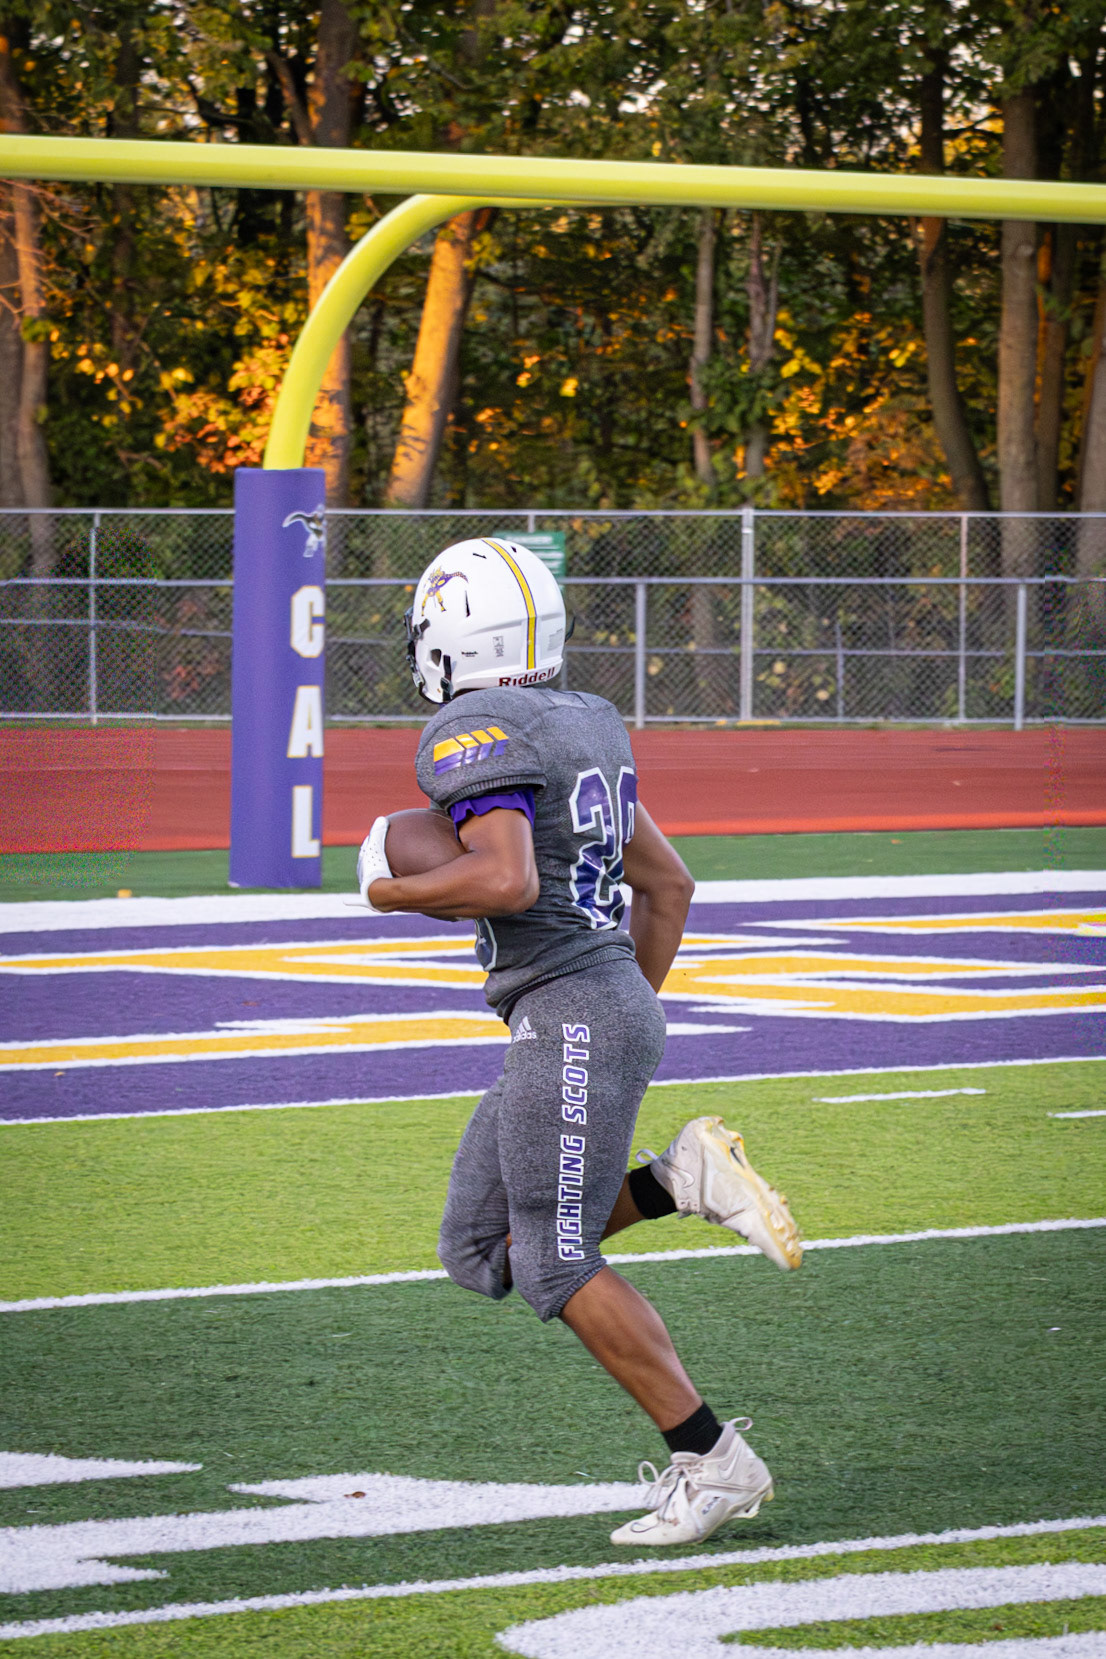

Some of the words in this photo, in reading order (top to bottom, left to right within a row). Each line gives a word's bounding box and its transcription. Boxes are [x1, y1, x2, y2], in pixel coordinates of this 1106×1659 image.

[287, 585, 325, 858] CAL
[499, 667, 555, 687] Riddell
[562, 1023, 590, 1125] SCOTS
[557, 1134, 585, 1260] FIGHTING
